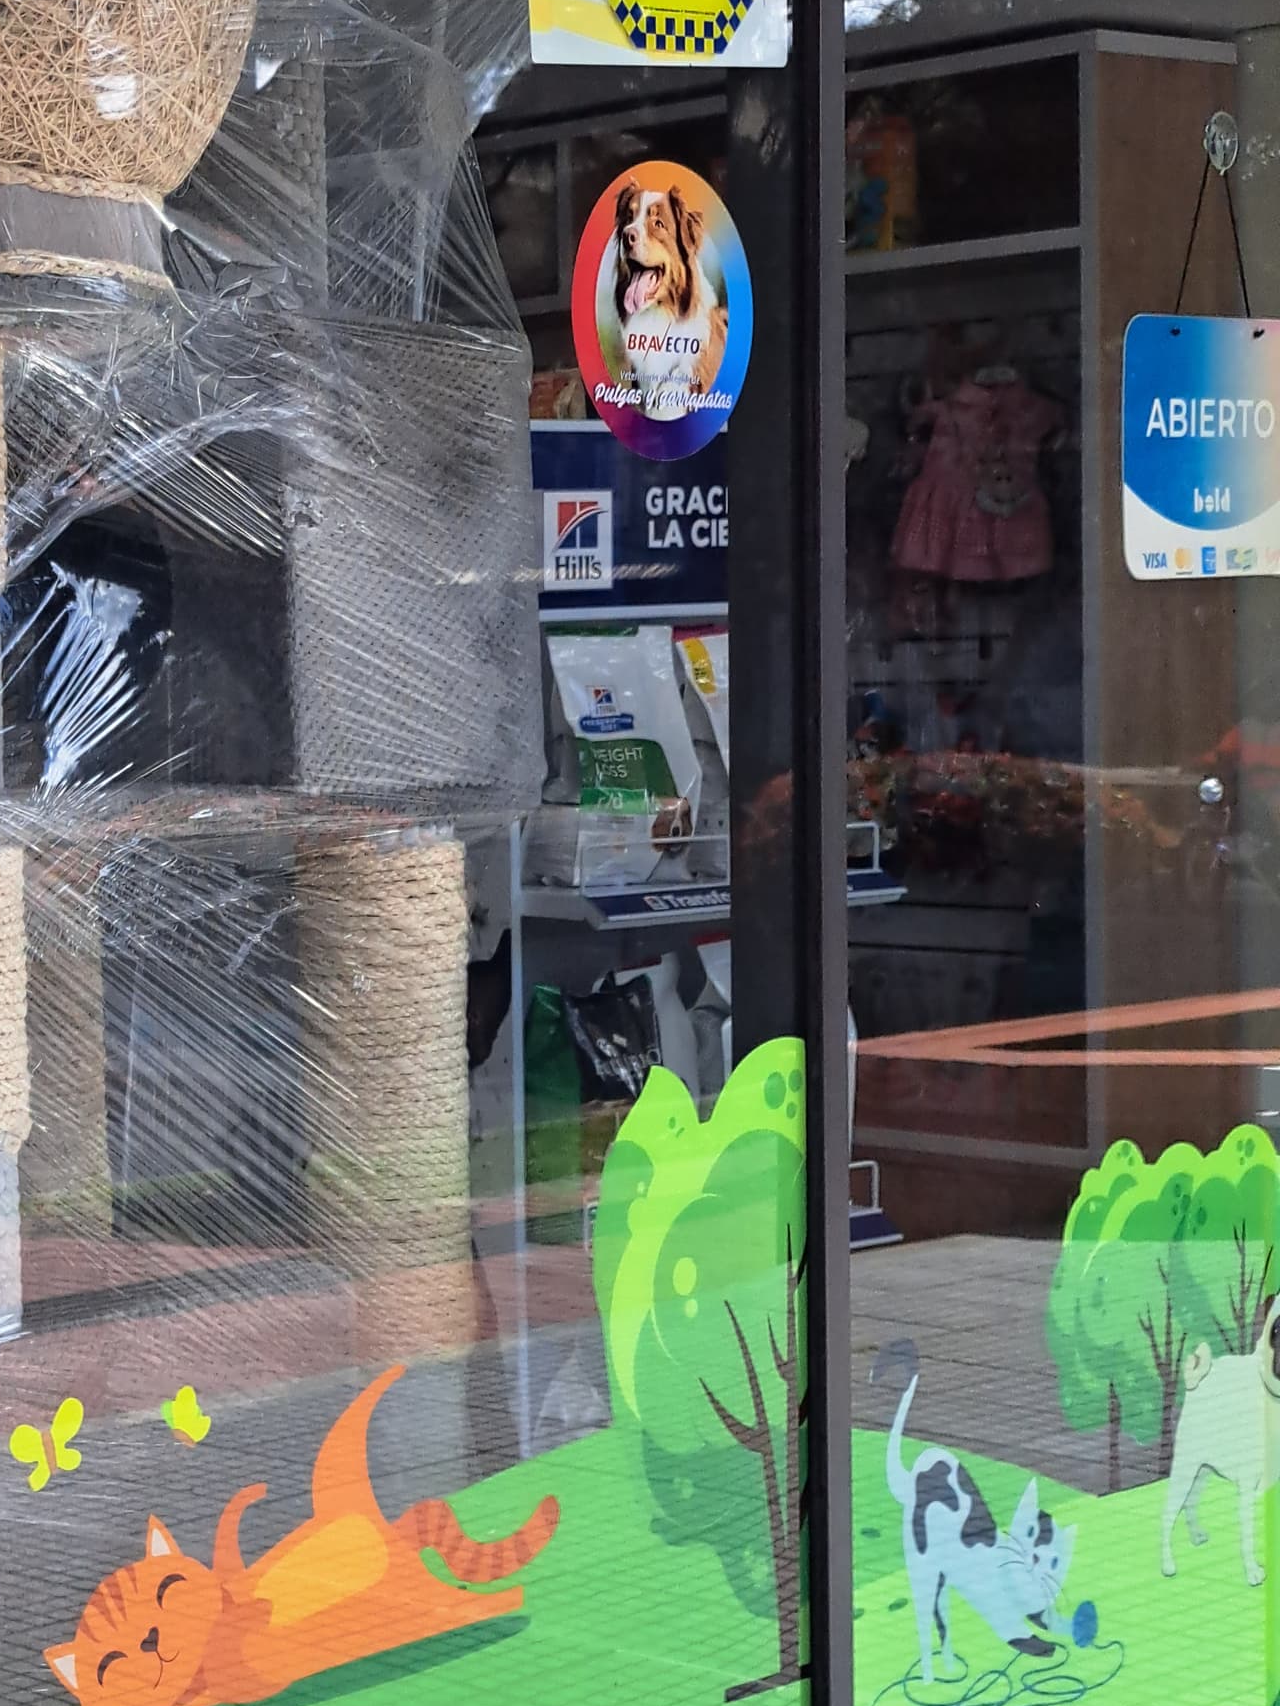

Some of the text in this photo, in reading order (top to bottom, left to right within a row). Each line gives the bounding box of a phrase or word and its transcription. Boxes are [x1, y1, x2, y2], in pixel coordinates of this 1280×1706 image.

[627, 328, 700, 356] BRAVECTO
[594, 382, 733, 412] Pulgas y garrapatas
[1146, 397, 1276, 438] ABIERTO
[645, 485, 728, 516] GRAC
[1193, 488, 1231, 513] bold
[648, 520, 684, 548] LA
[555, 555, 602, 581] Hill's
[1143, 552, 1168, 569] VISA
